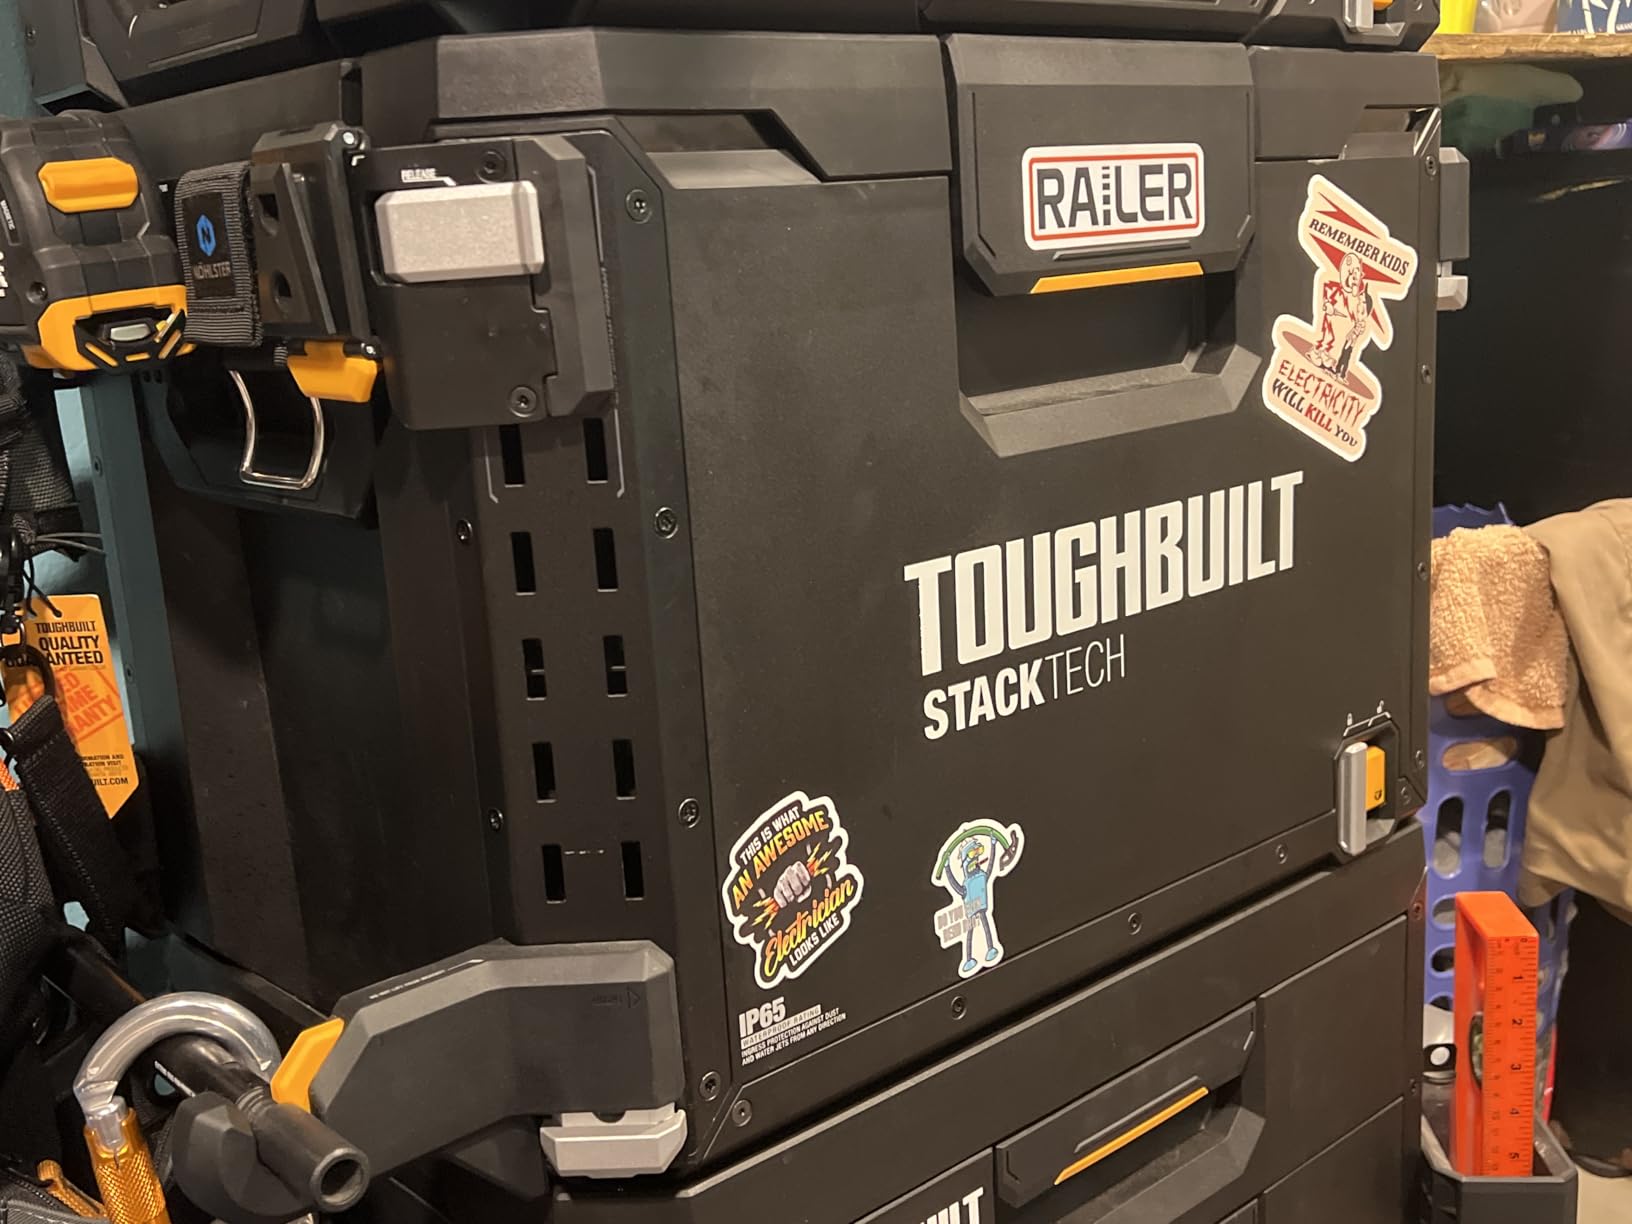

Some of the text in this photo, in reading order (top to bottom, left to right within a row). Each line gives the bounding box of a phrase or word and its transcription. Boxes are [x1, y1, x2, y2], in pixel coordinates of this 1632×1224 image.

[1036, 163, 1193, 230] RAILER
[1308, 218, 1410, 276] REMEMBER KIDS
[1272, 378, 1358, 447] WILL KILL YOU
[1278, 359, 1366, 428] ELECTRICITY
[903, 470, 1304, 677] TOUGHBUILT
[35, 620, 96, 634] TOUGHBUILT
[39, 635, 99, 651] QUALITY
[923, 633, 1127, 741] STACKTECH
[732, 810, 830, 910] AN AWESOME
[739, 806, 801, 866] THIS IS WHAT
[764, 879, 854, 977] Electrician
[789, 912, 840, 966] LOOKS LIKE
[738, 996, 786, 1038] IP65
[741, 1007, 840, 1058] INGRESS PROTECTION AGAINST DUST
[741, 1013, 847, 1066] AND WATER JETS FROM ANY DIRECTION
[742, 1005, 820, 1047] WATERPROOF RATING
[1512, 1018, 1523, 1026] 2
[1511, 1063, 1522, 1071] 3
[1509, 1152, 1519, 1160] 5
